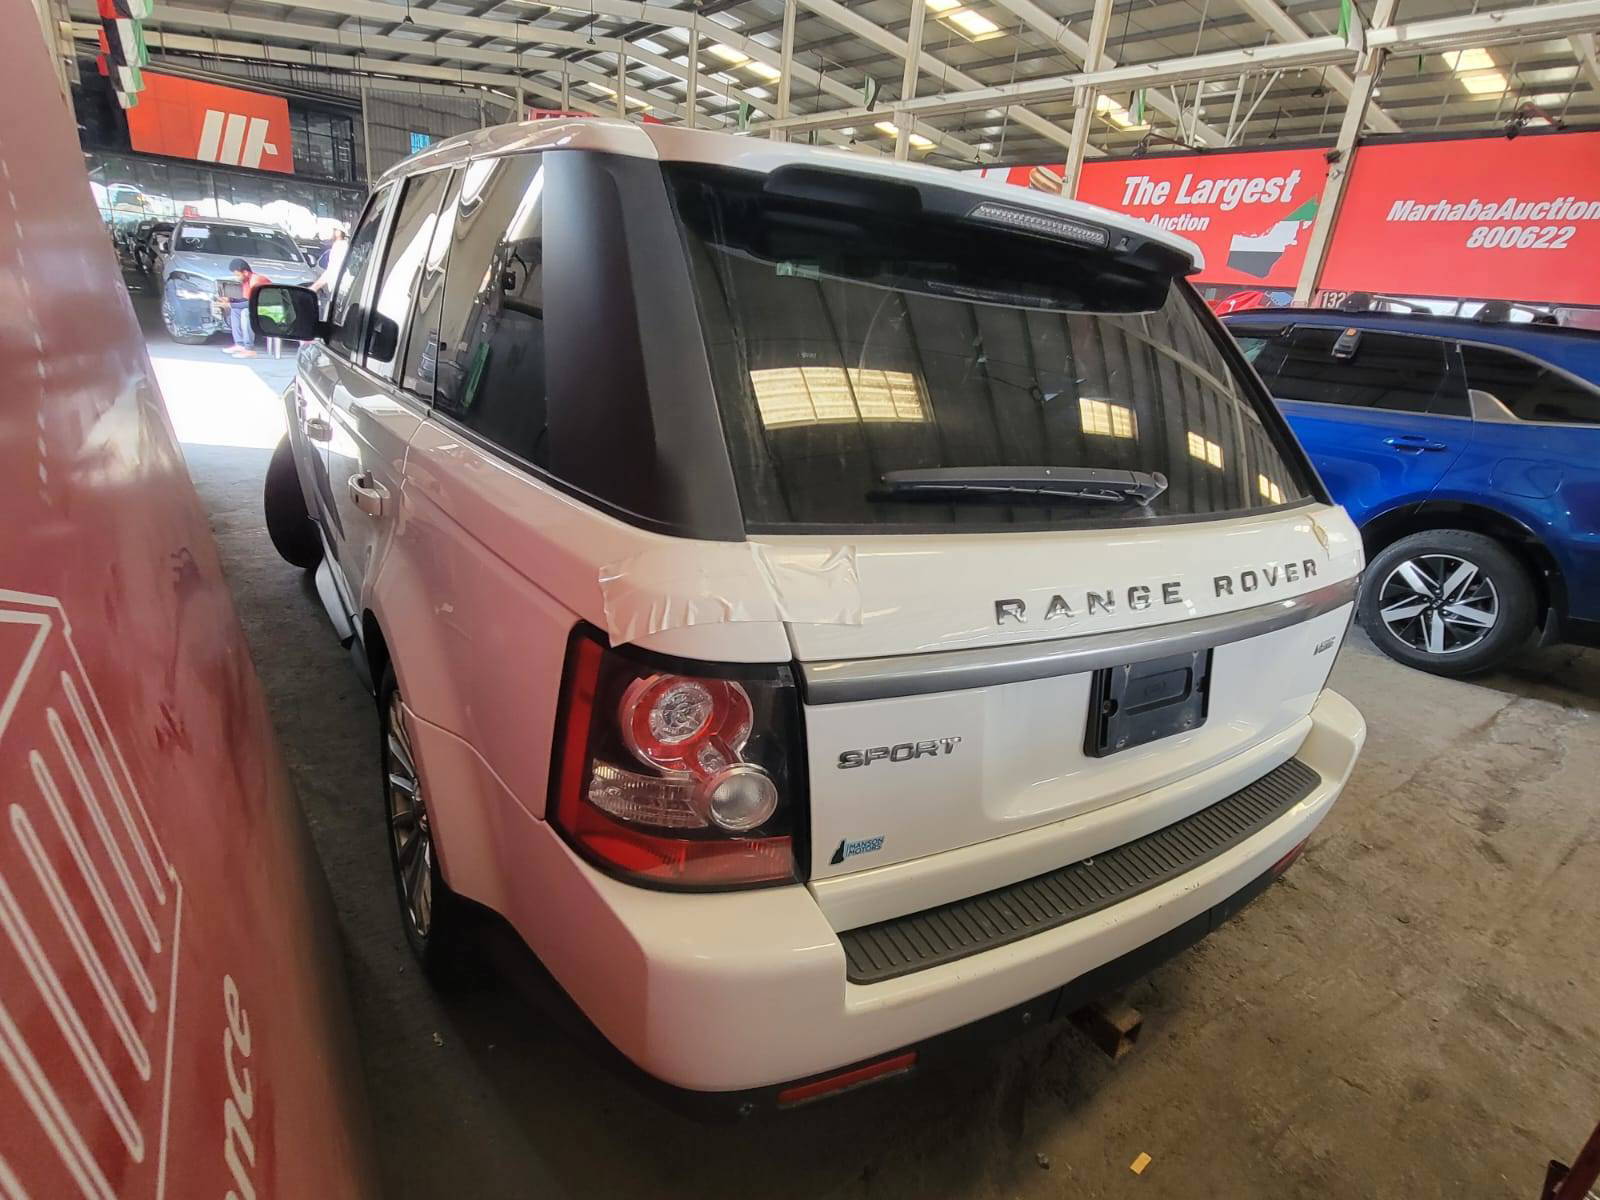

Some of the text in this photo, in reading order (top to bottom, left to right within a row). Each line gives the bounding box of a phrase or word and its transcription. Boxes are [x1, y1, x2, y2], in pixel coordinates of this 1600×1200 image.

[1122, 169, 1301, 212] The Largest
[1149, 213, 1210, 231] Auction
[1386, 196, 1600, 221] MarhabaAuction
[1466, 226, 1576, 249] 800622
[995, 558, 1318, 625] RANGE ROVER
[837, 736, 962, 769] SPORT
[847, 844, 882, 857] MOTORS
[223, 973, 256, 1200] nce
